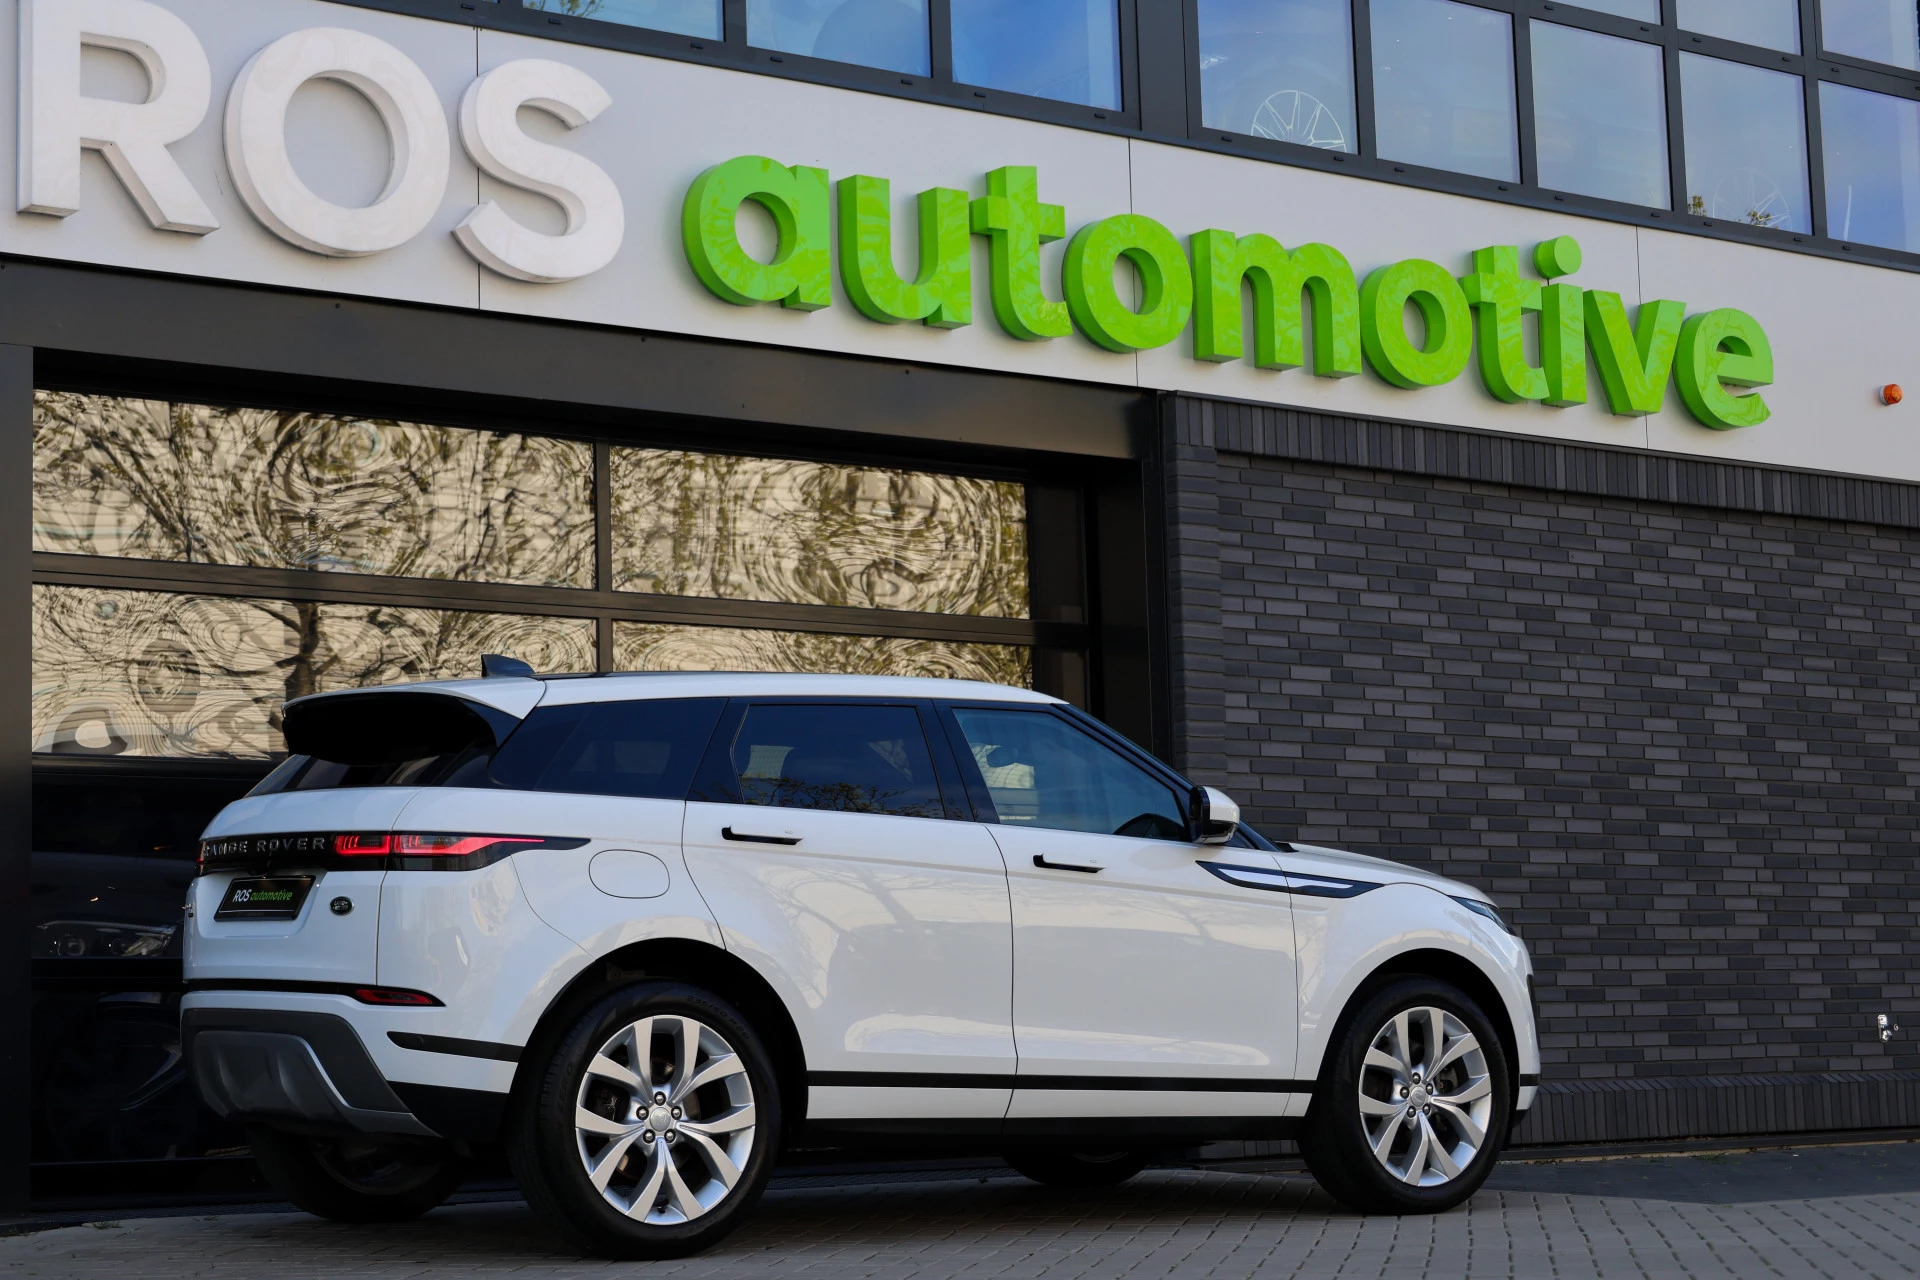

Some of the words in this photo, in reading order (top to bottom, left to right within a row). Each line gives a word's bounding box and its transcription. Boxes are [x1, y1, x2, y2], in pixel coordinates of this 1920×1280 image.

[16, 0, 625, 283] ROS
[681, 154, 1774, 430] automotive
[257, 837, 325, 853] ROVER
[232, 889, 252, 902] ROS
[250, 889, 294, 901] automotive
